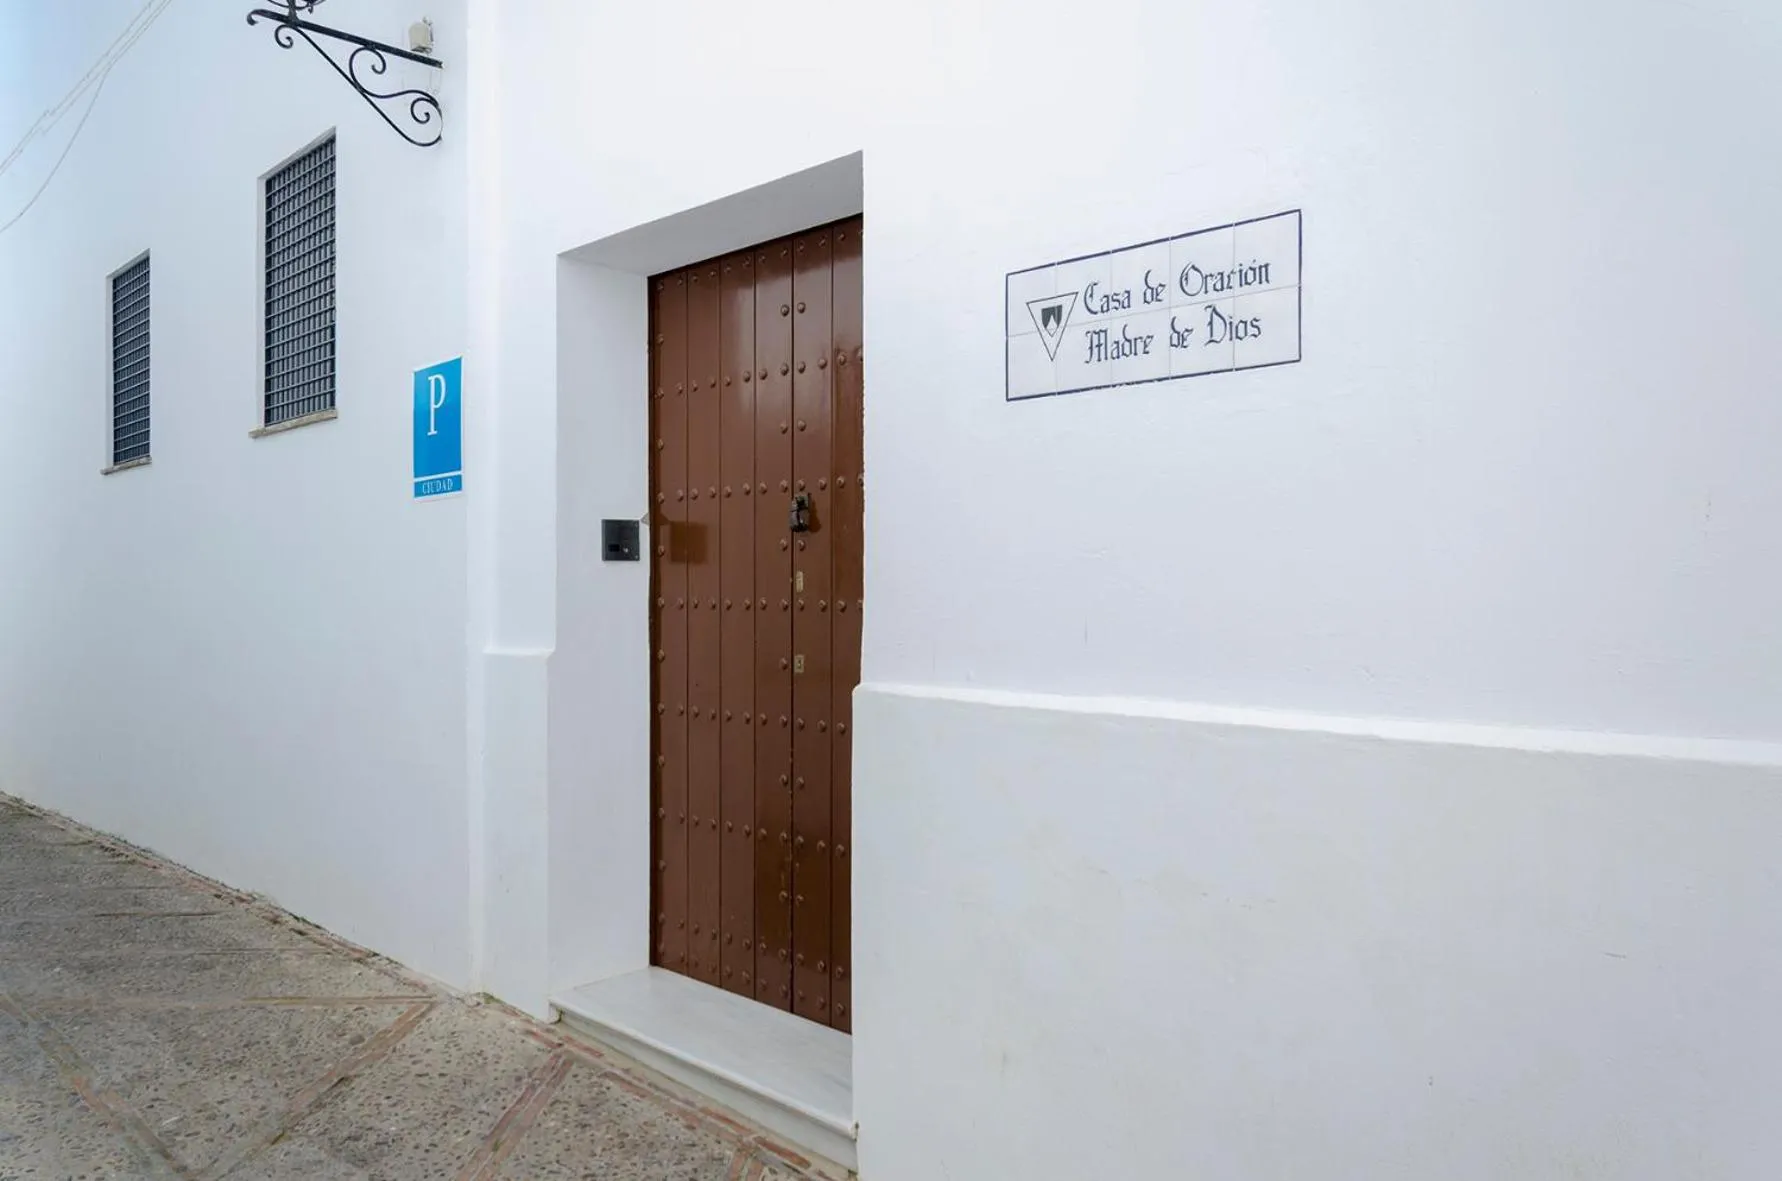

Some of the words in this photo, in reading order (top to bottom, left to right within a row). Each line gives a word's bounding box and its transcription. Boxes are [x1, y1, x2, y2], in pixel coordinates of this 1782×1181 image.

[1083, 280, 1132, 315] Casa
[1143, 268, 1167, 305] de
[1179, 259, 1271, 298] Oración
[1084, 324, 1155, 364] Madre
[1169, 316, 1194, 349] de
[1204, 304, 1262, 347] Dios
[427, 373, 447, 436] P
[422, 478, 454, 495] CIUDAD
